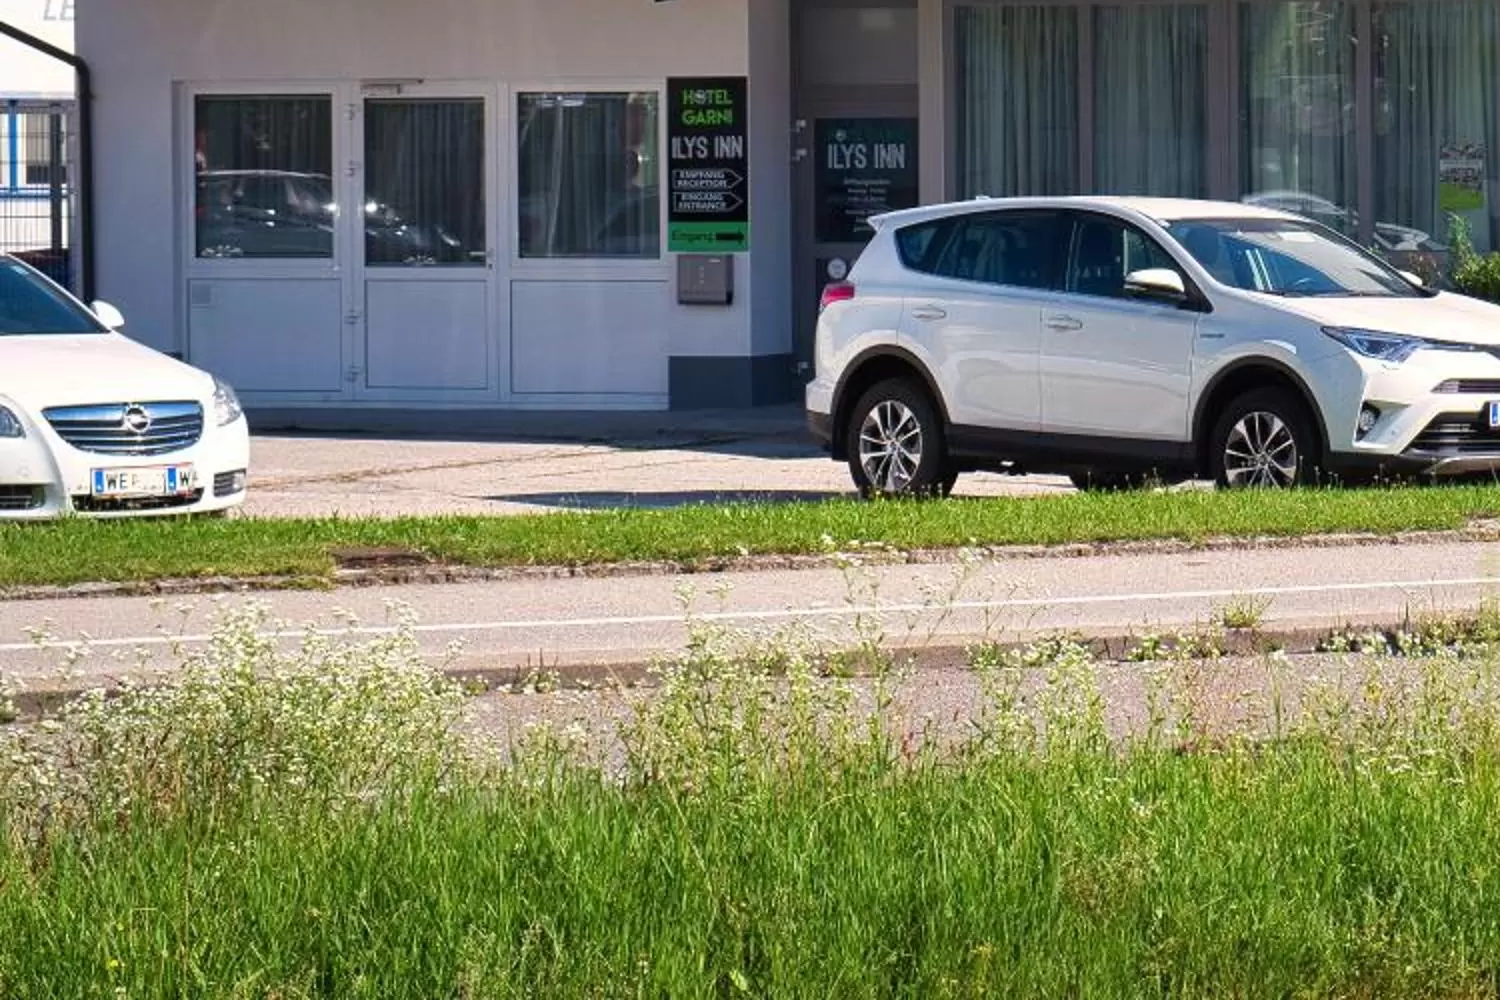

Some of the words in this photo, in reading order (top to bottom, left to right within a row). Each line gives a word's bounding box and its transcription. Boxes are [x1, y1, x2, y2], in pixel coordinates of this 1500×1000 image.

[682, 89, 733, 105] HOTEL
[681, 109, 733, 126] GARNI
[671, 135, 708, 160] ILYS
[713, 135, 744, 160] INN
[827, 143, 867, 169] ILYS
[874, 143, 905, 169] INN
